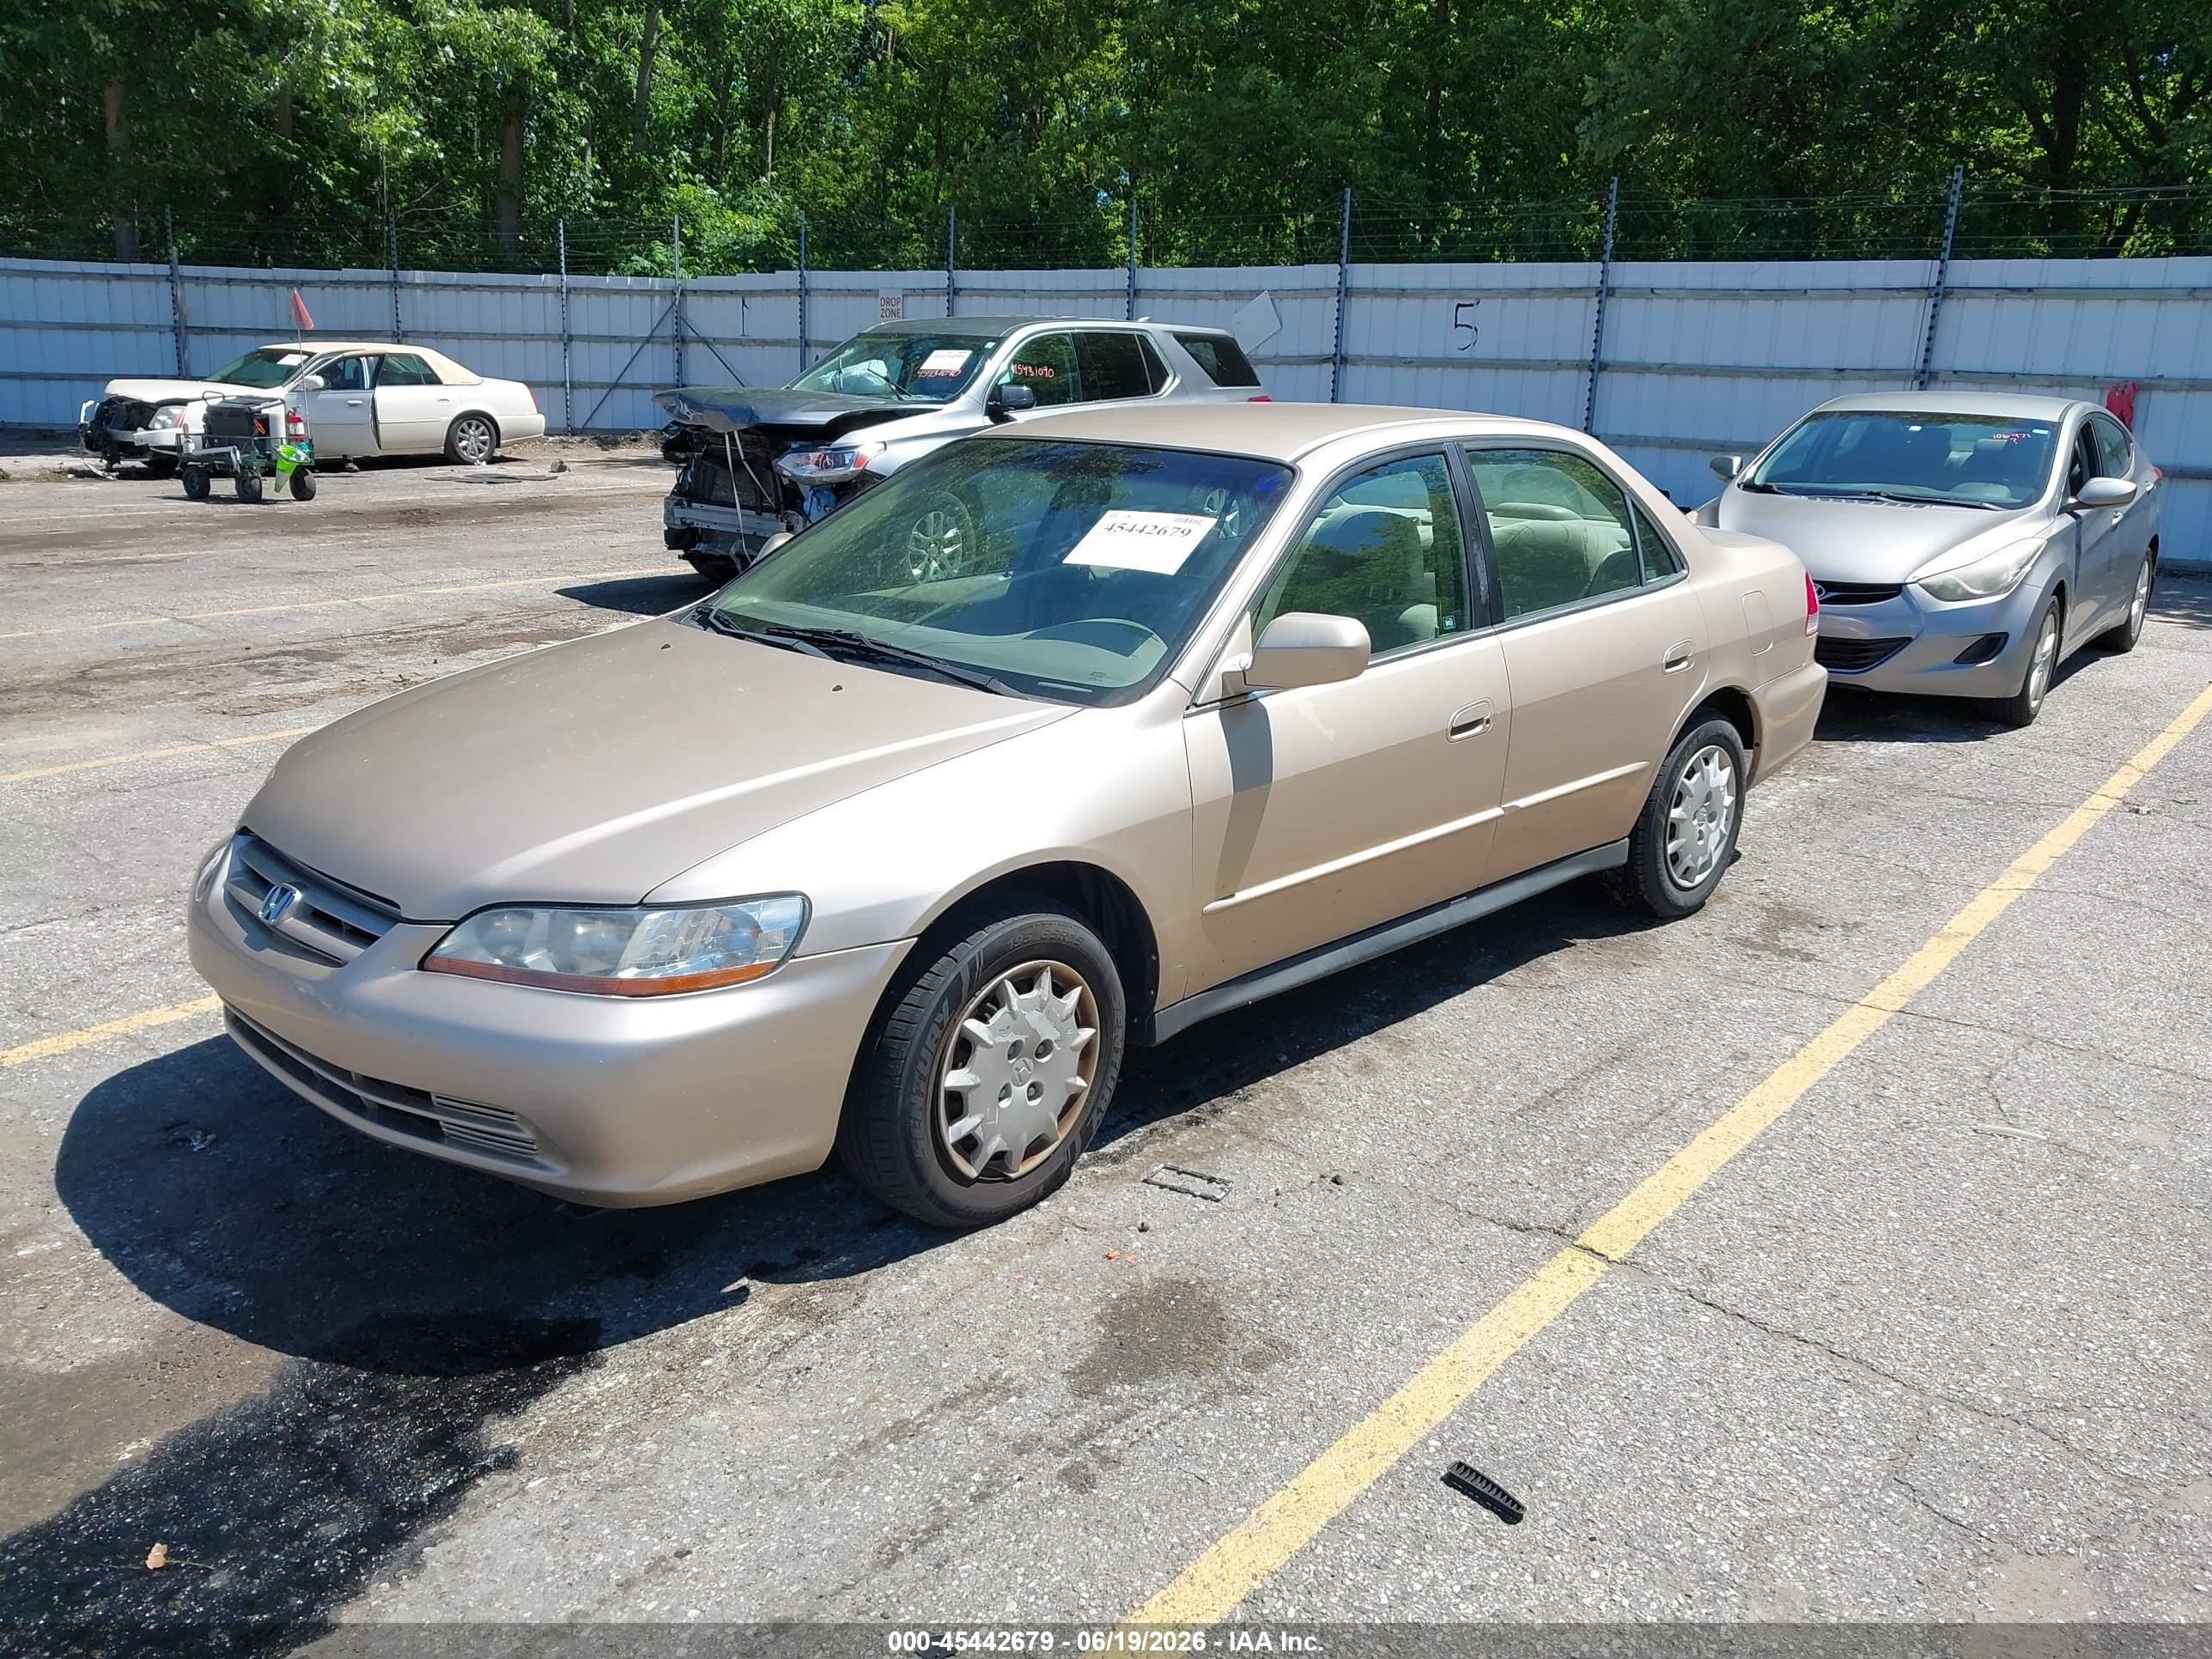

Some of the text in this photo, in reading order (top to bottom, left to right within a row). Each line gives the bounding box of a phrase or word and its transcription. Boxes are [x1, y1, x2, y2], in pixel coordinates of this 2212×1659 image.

[880, 297, 901, 307] DROP
[880, 308, 900, 318] ZONE
[1455, 298, 1480, 350] 5
[1103, 522, 1192, 538] 45442679
